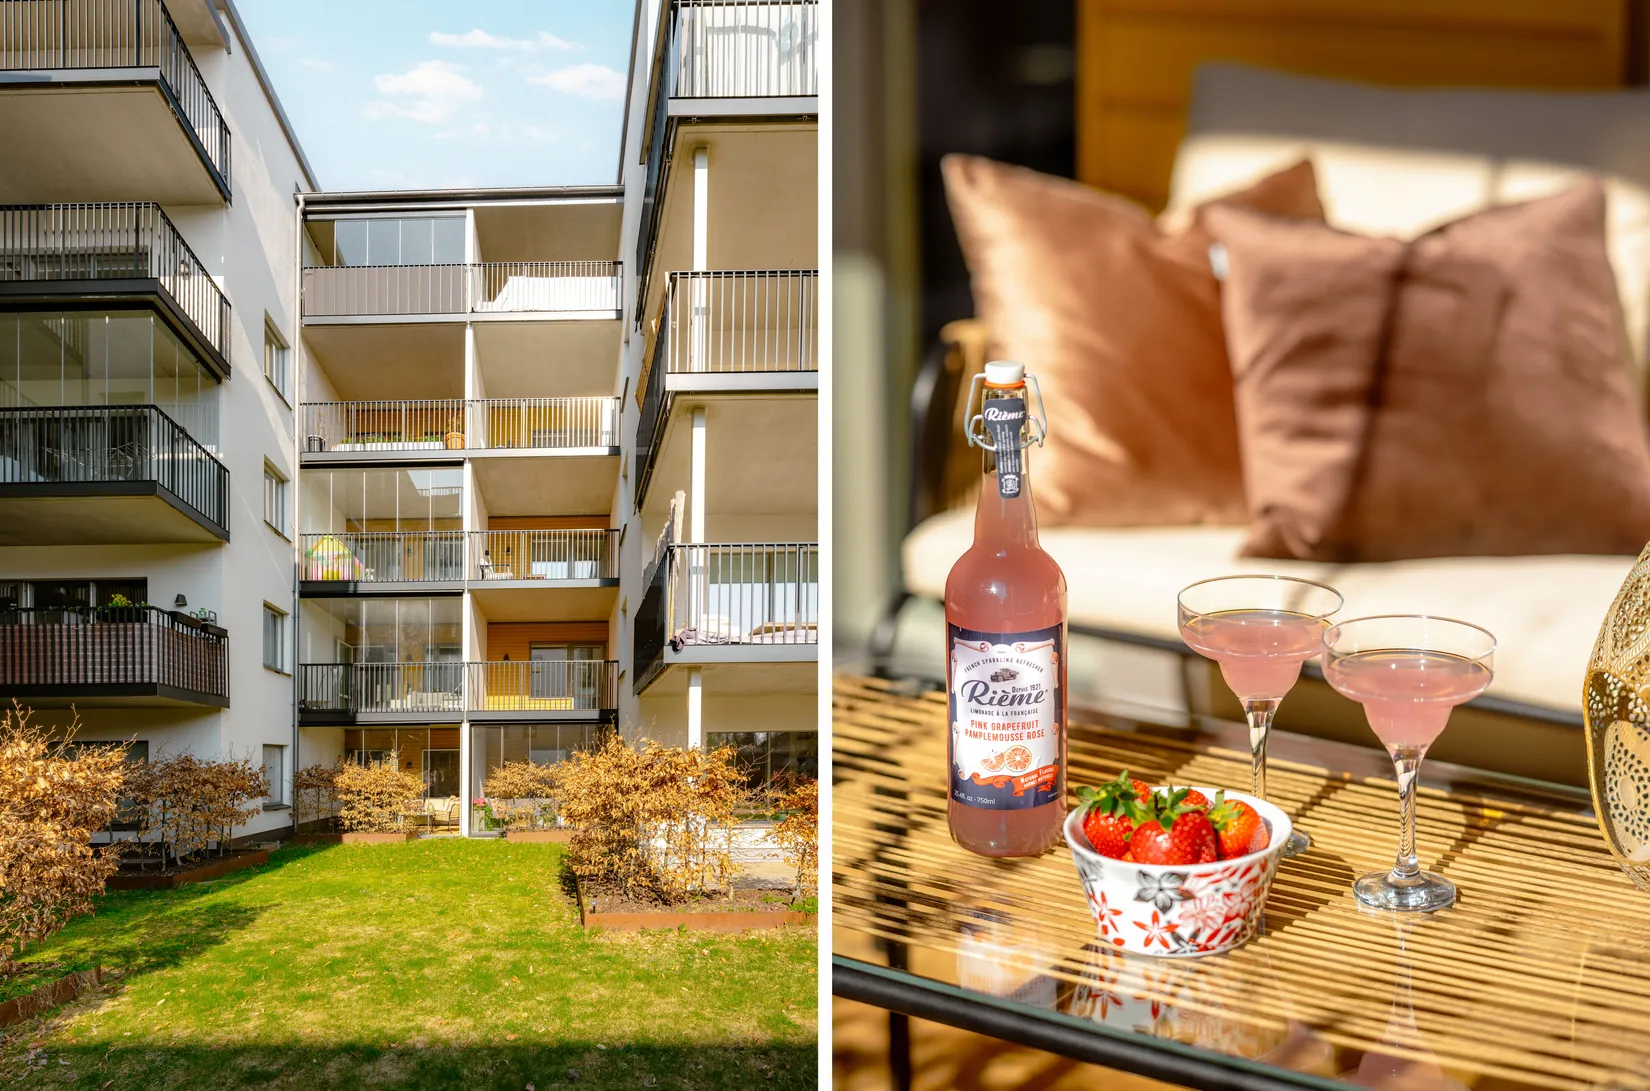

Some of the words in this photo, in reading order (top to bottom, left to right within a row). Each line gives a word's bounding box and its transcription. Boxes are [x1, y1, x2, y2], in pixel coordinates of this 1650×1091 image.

[964, 661, 981, 673] FRENCH
[982, 657, 1014, 665] SPARKLING
[1016, 658, 1044, 673] REFRESHER
[1030, 683, 1041, 691] 1921
[970, 708, 994, 716] LIMONADE
[1010, 708, 1039, 716] FRANÇAISE
[970, 719, 988, 730] PINK
[991, 719, 1039, 731] GRAPEFRUIT
[965, 728, 1024, 742] PAMPLEMOUSSE
[1027, 728, 1045, 739] ROSE
[977, 797, 996, 805] 750ml
